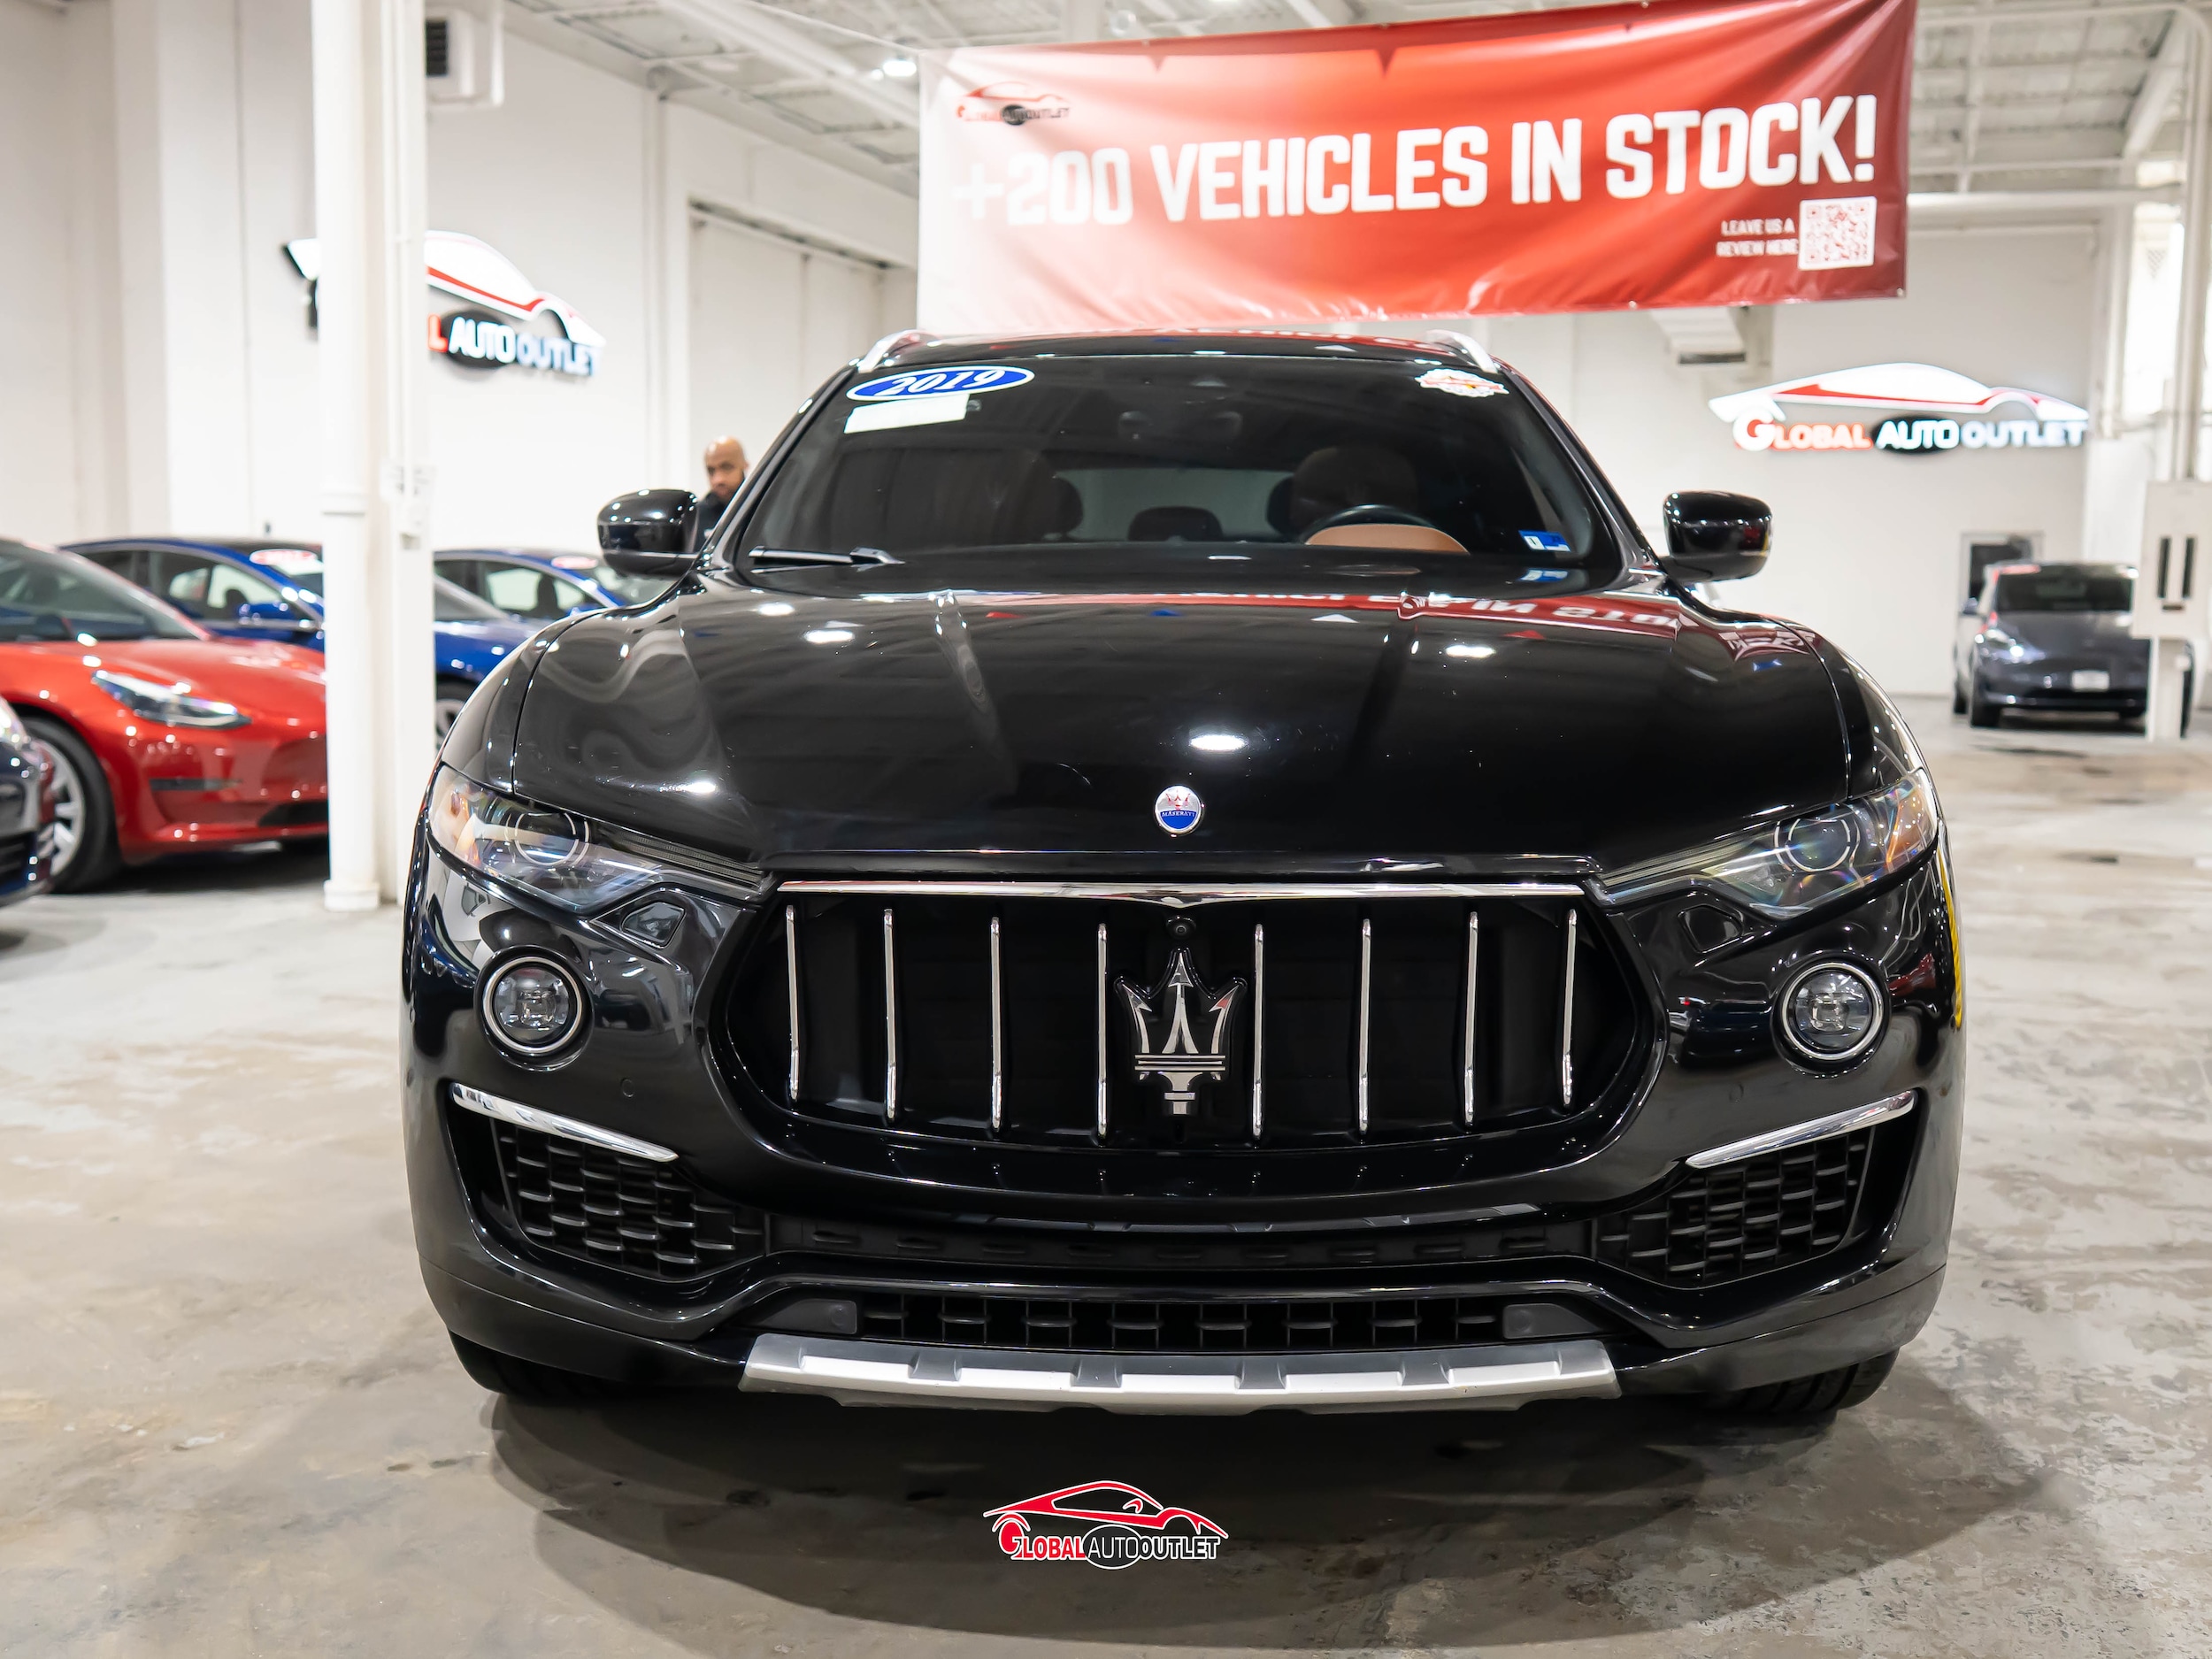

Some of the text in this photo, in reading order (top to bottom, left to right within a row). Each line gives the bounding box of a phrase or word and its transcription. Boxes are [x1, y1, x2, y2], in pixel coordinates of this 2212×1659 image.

[951, 94, 1878, 226] +200 VEHICLES IN STOCK!
[1721, 219, 1763, 236] LEAVE
[1784, 218, 1795, 234] A
[448, 317, 516, 364] AUTO
[516, 334, 602, 377] OUTLET
[873, 369, 1006, 396] 2019
[1732, 403, 2087, 452] GLOBAL AUTO OUTLET
